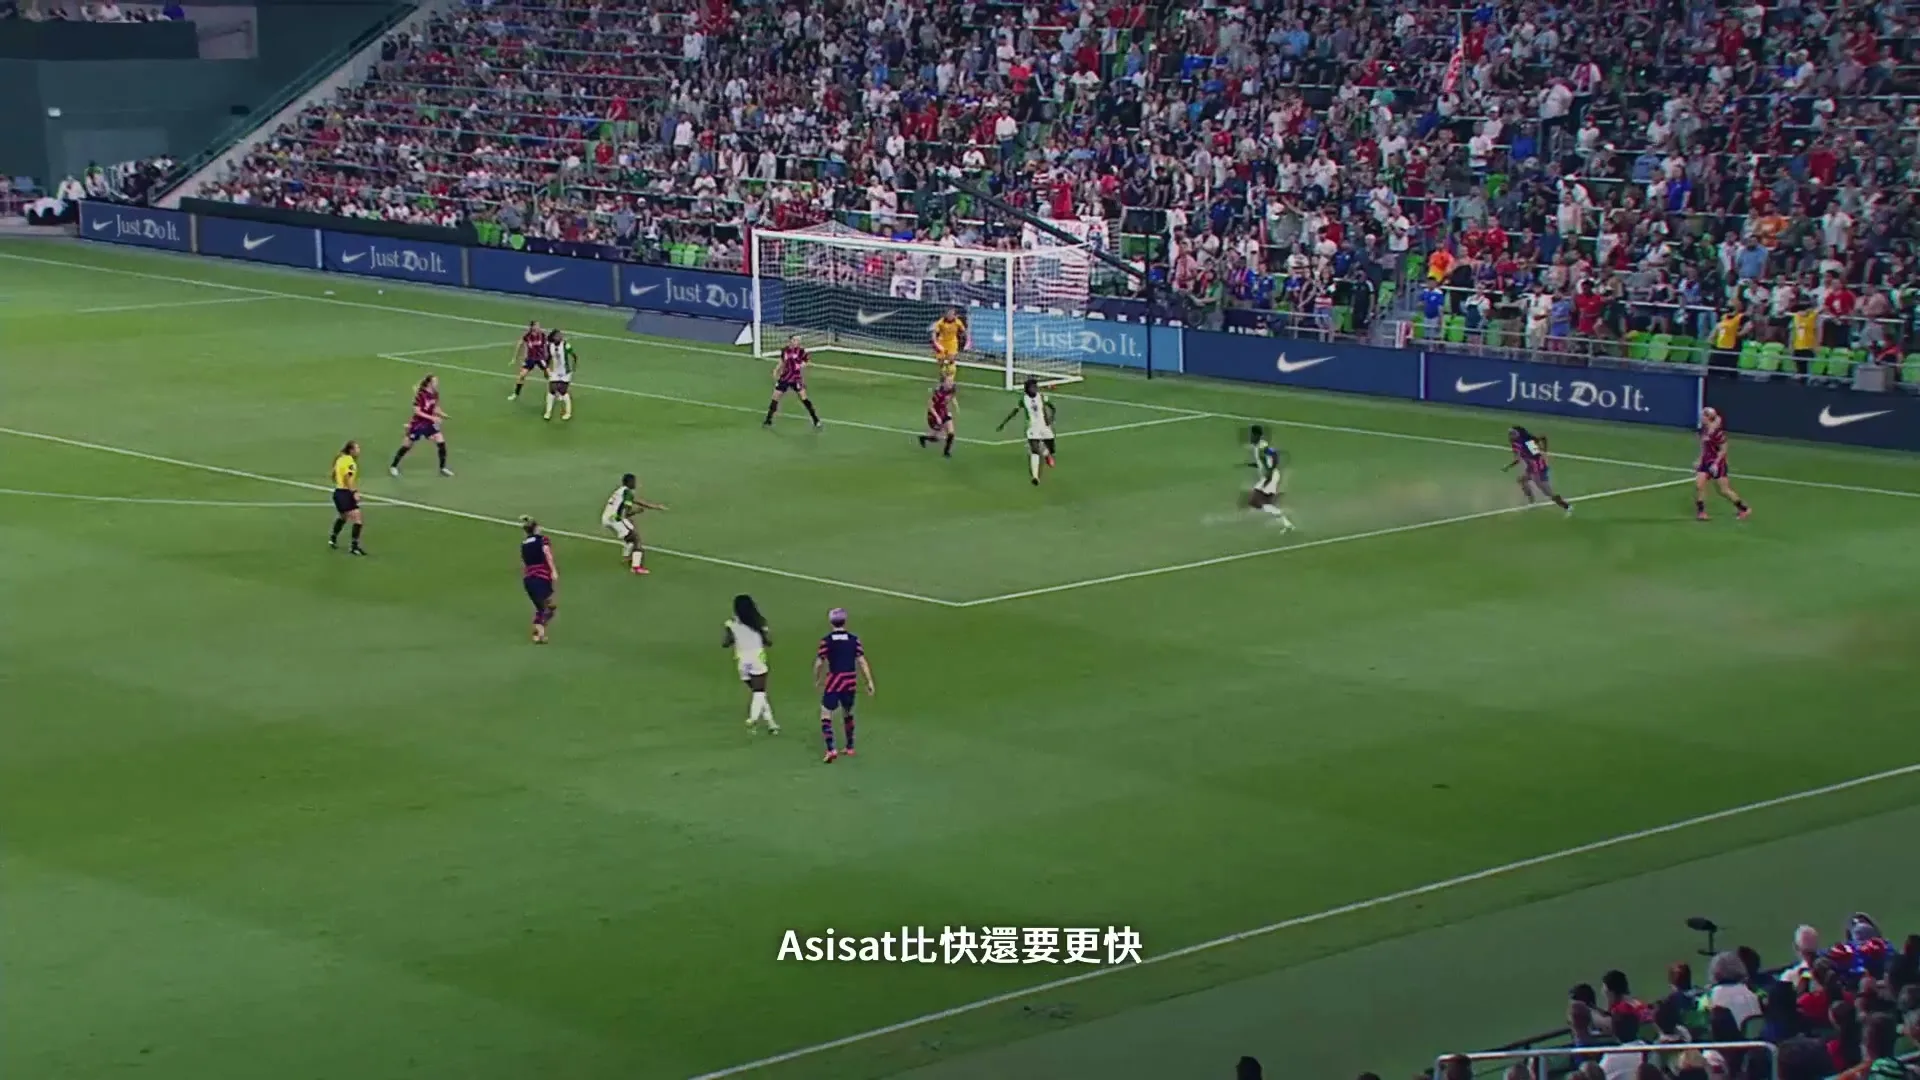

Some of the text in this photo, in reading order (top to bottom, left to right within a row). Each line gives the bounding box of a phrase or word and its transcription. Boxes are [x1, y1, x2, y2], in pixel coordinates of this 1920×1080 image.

[116, 214, 180, 241] Just Do It.
[370, 245, 446, 273] Just Do It.
[664, 278, 701, 304] Just
[706, 284, 738, 308] Do
[1033, 323, 1142, 357] Just Do It.
[1507, 372, 1651, 412] Just Do It.
